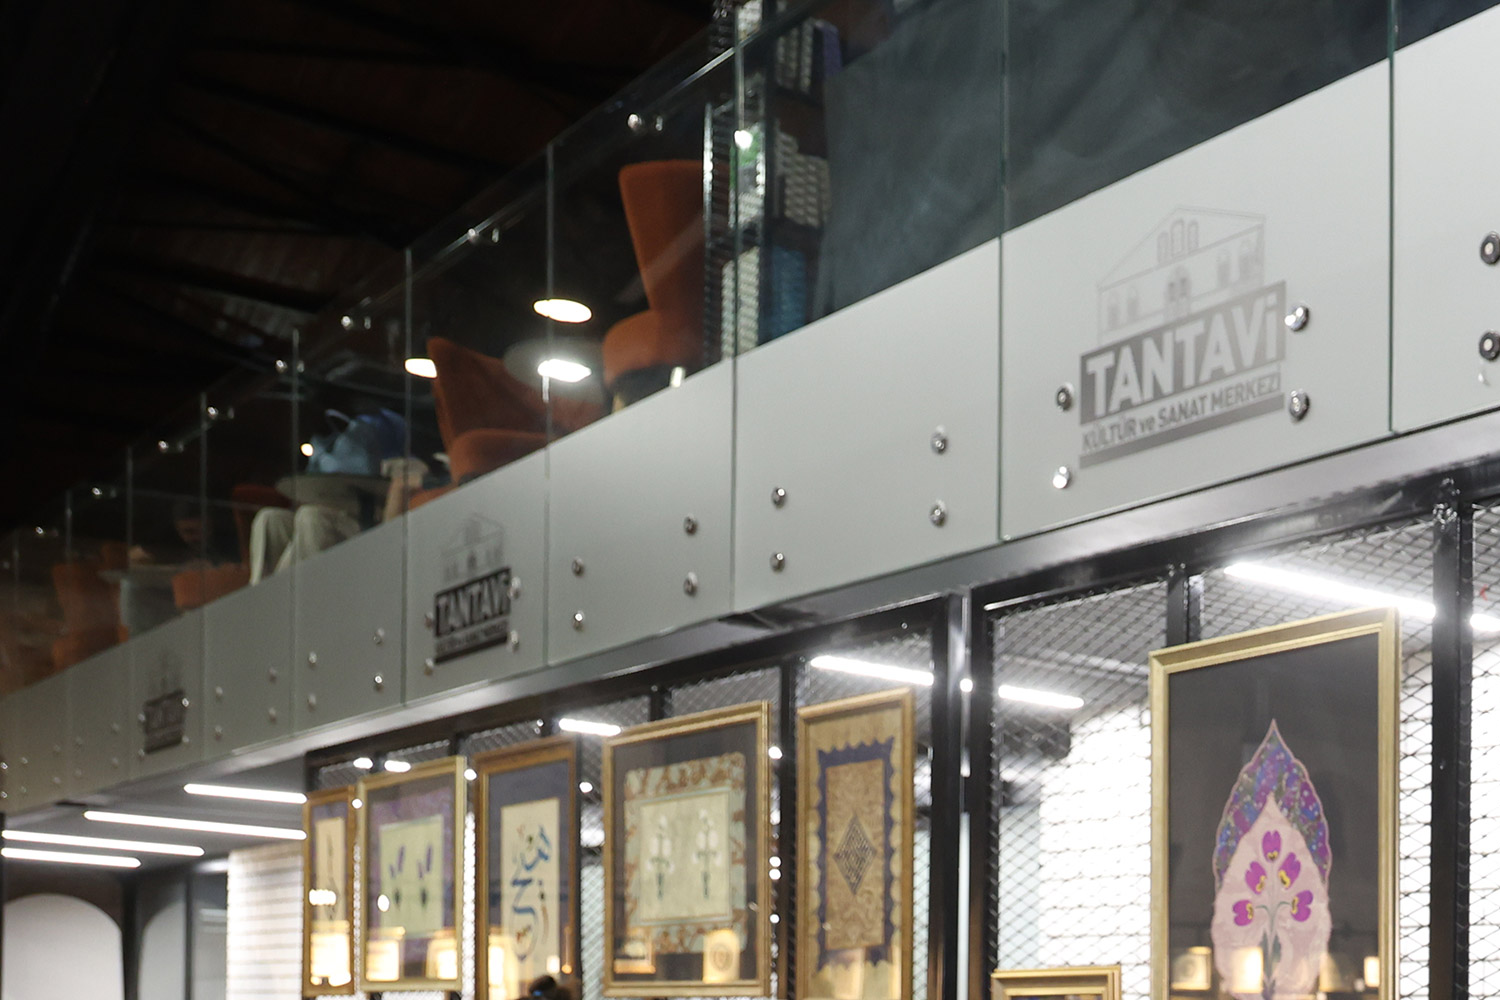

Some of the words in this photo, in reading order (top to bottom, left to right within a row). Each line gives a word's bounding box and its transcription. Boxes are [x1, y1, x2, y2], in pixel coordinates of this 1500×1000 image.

[1086, 292, 1277, 418] TANTAVİ
[1082, 414, 1137, 450] KÜLTÜR
[1139, 417, 1155, 434] ve
[1157, 395, 1207, 427] SANAT
